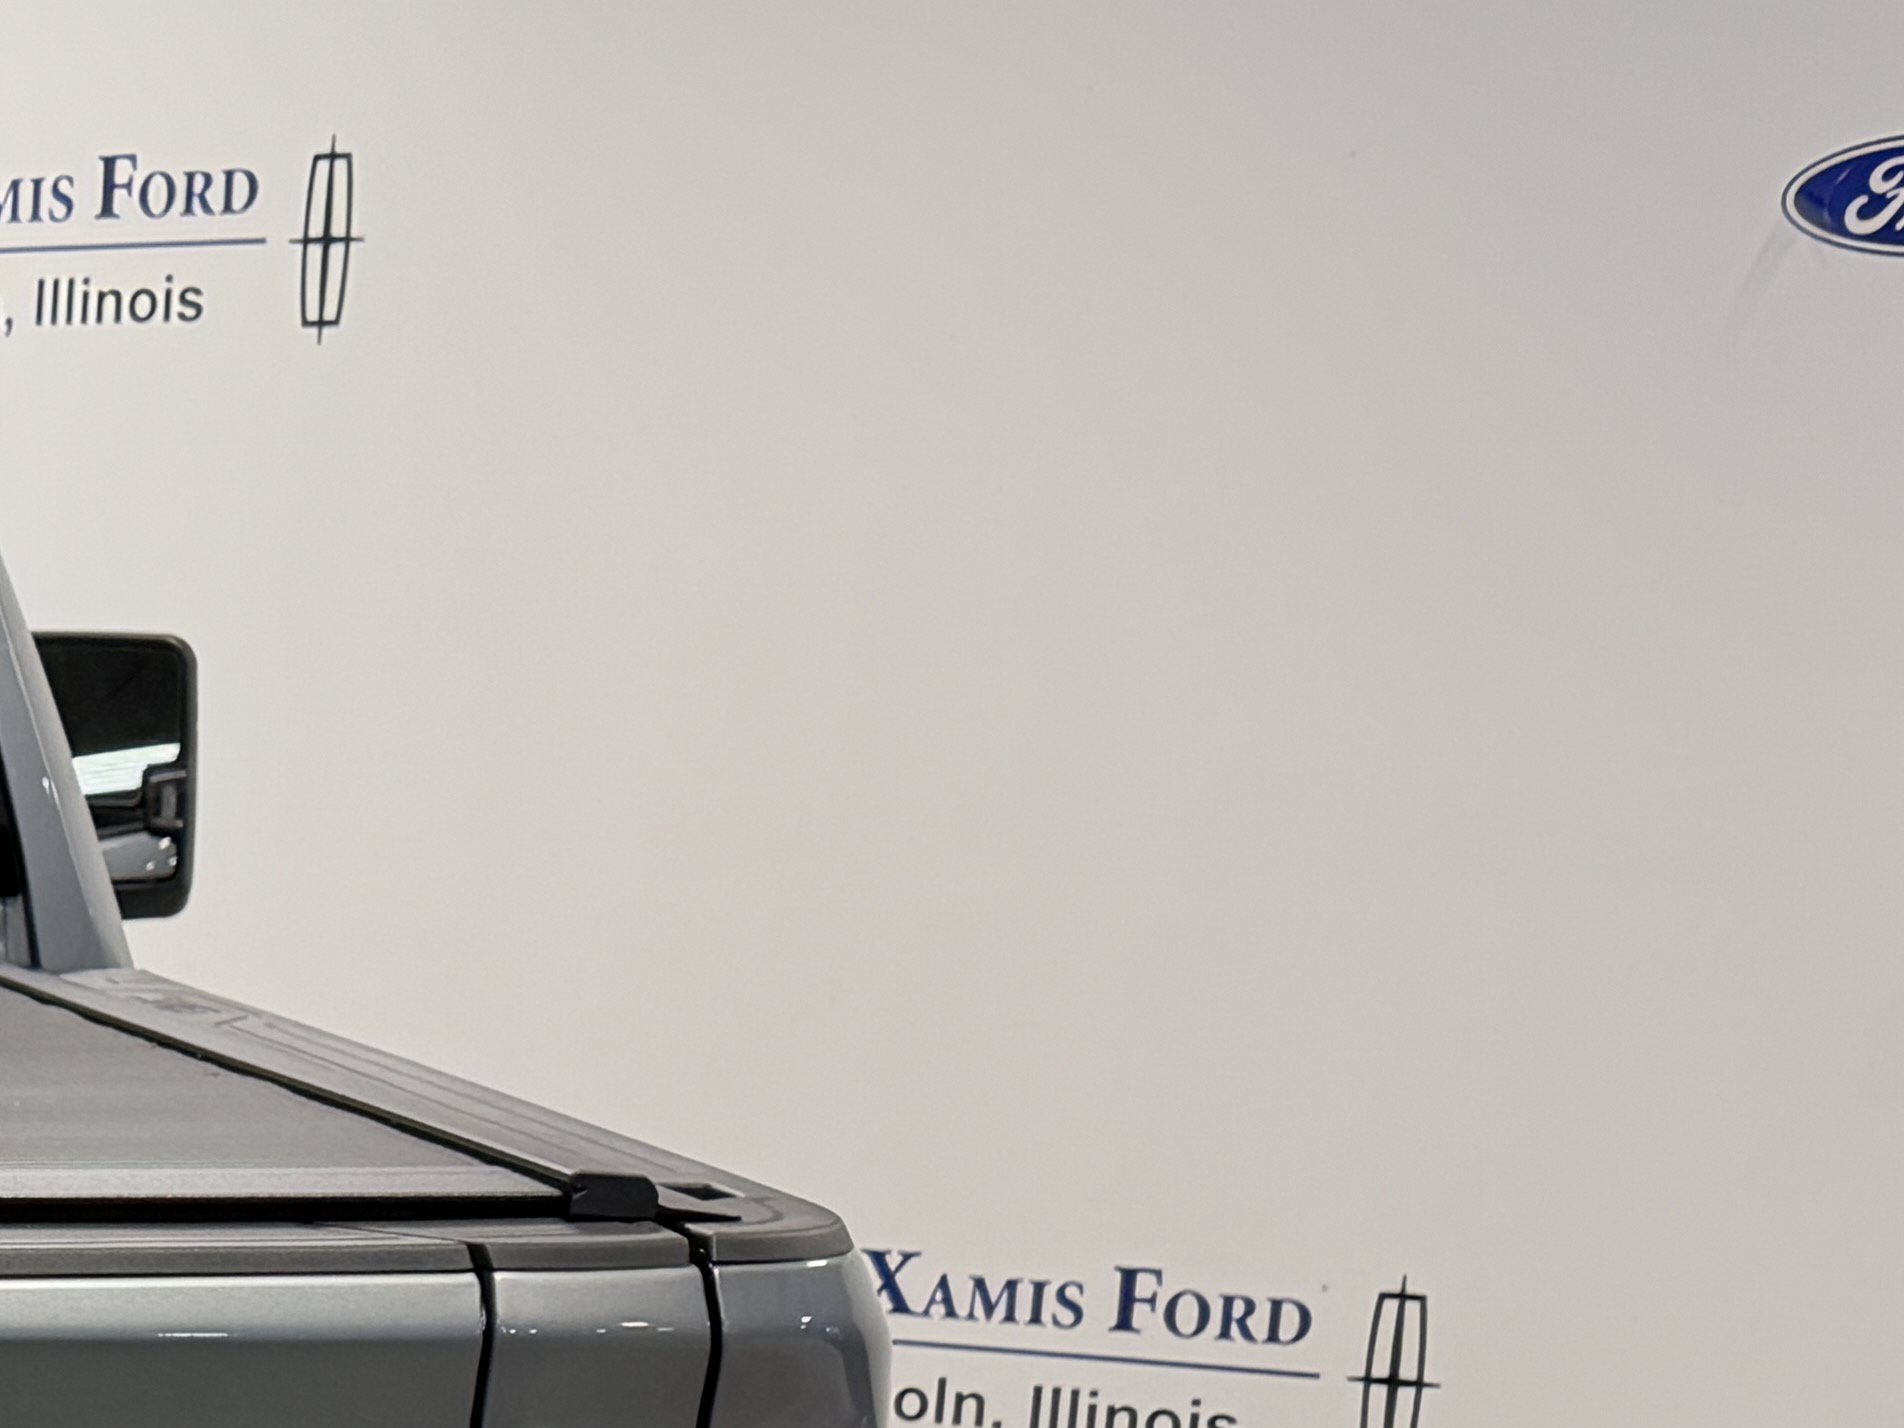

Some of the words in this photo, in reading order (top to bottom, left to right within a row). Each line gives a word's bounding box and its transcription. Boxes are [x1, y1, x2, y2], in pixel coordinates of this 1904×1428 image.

[95, 153, 259, 220] FORD
[35, 274, 204, 326] Illinois
[862, 1249, 1084, 1330] XAMIS
[1108, 1266, 1312, 1345] FORD
